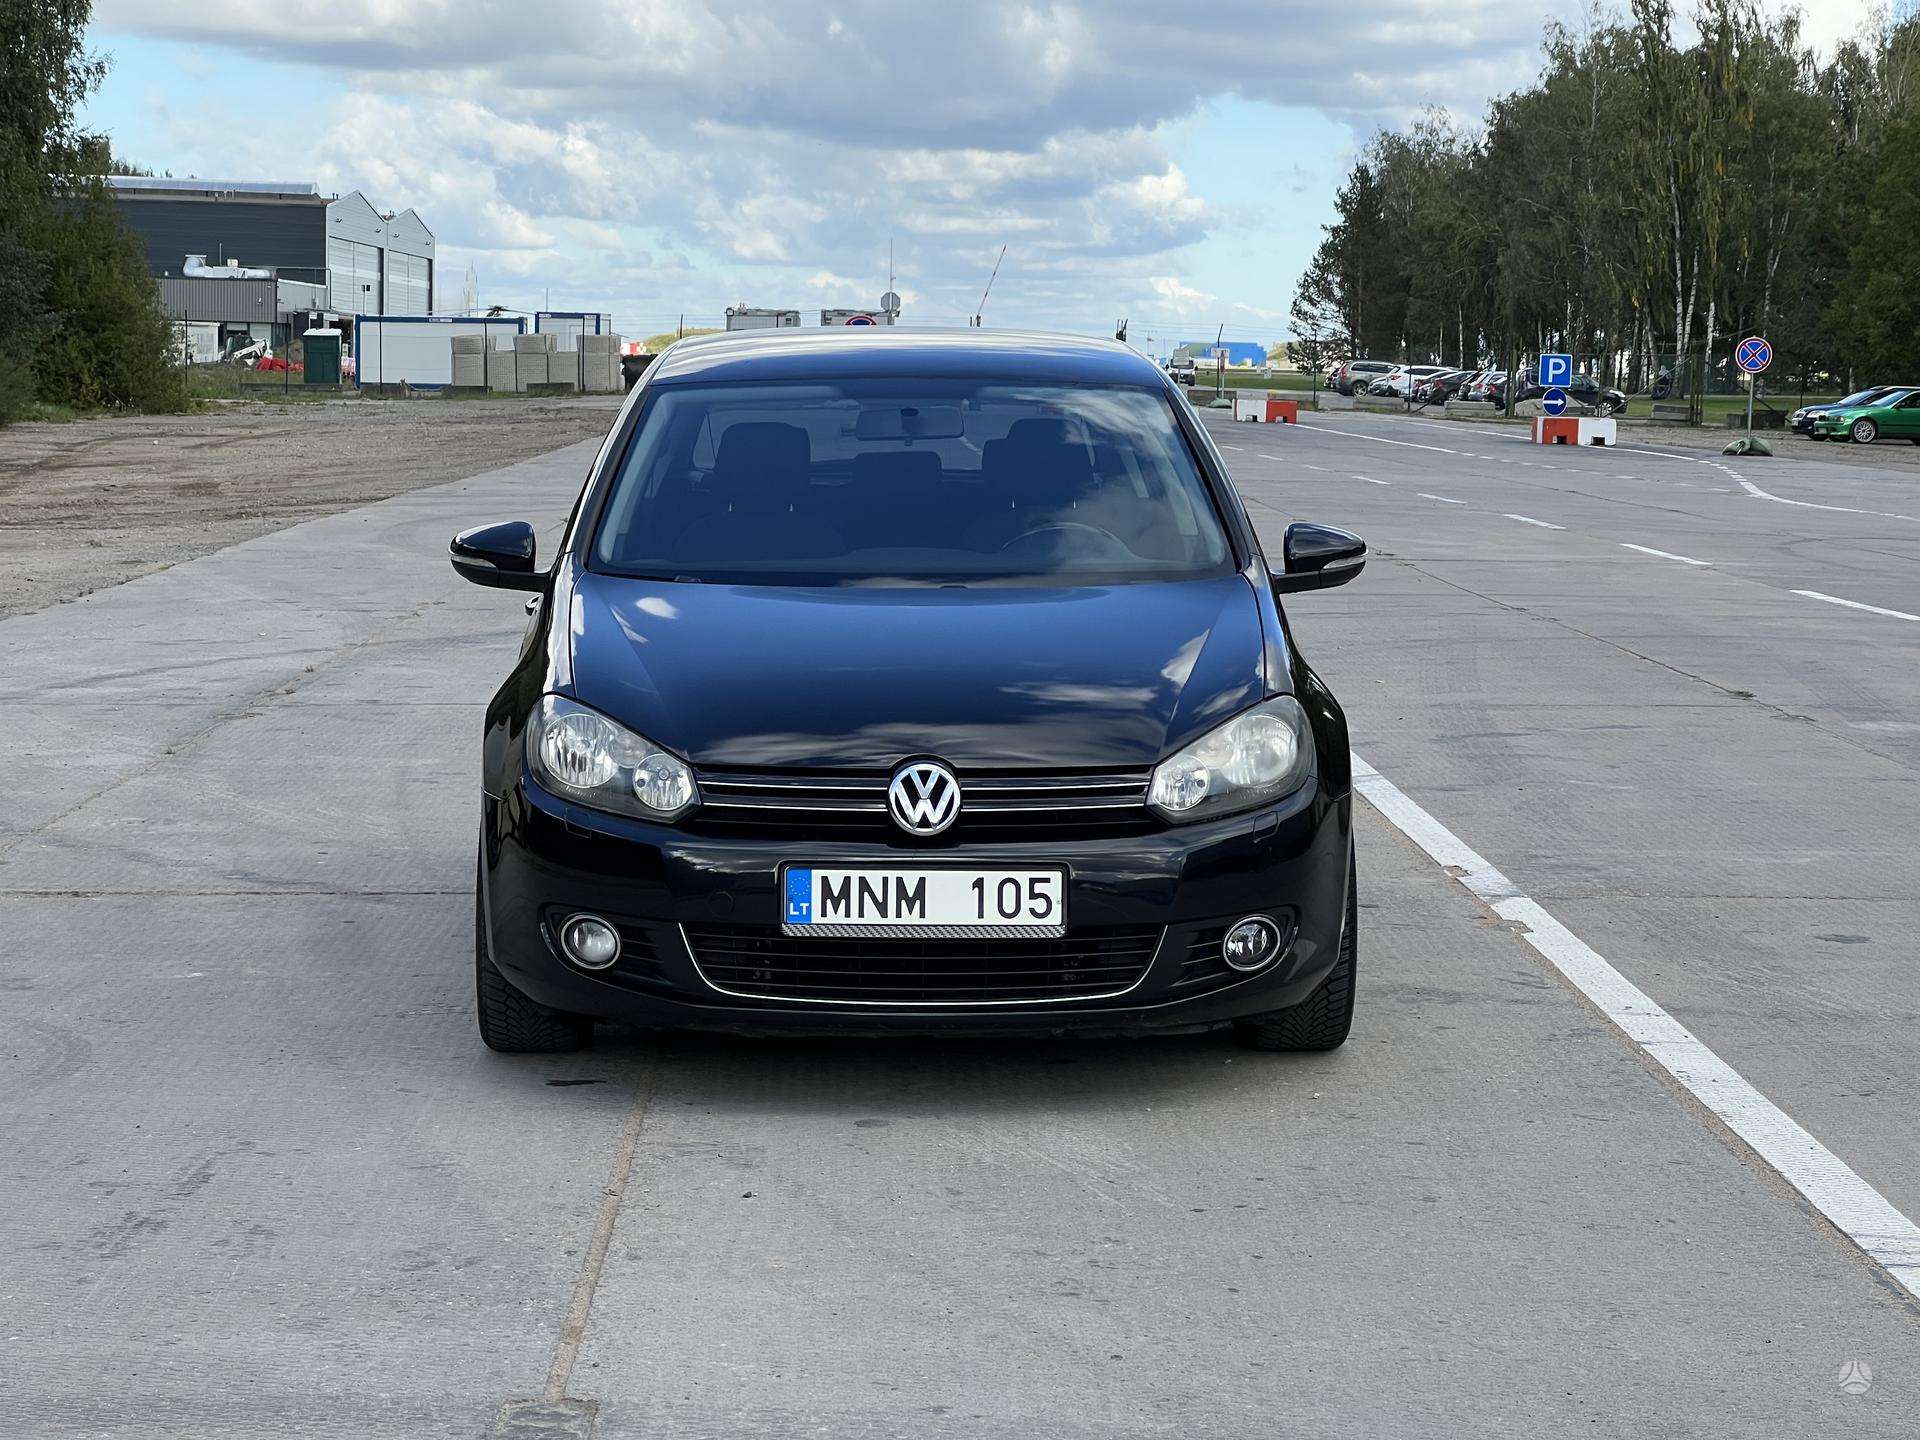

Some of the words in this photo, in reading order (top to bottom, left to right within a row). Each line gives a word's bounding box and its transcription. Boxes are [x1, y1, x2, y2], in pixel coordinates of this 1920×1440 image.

[1548, 358, 1566, 383] P
[892, 765, 958, 831] VW
[790, 902, 809, 915] LT
[820, 875, 926, 919] MNM
[971, 877, 1053, 919] 105
